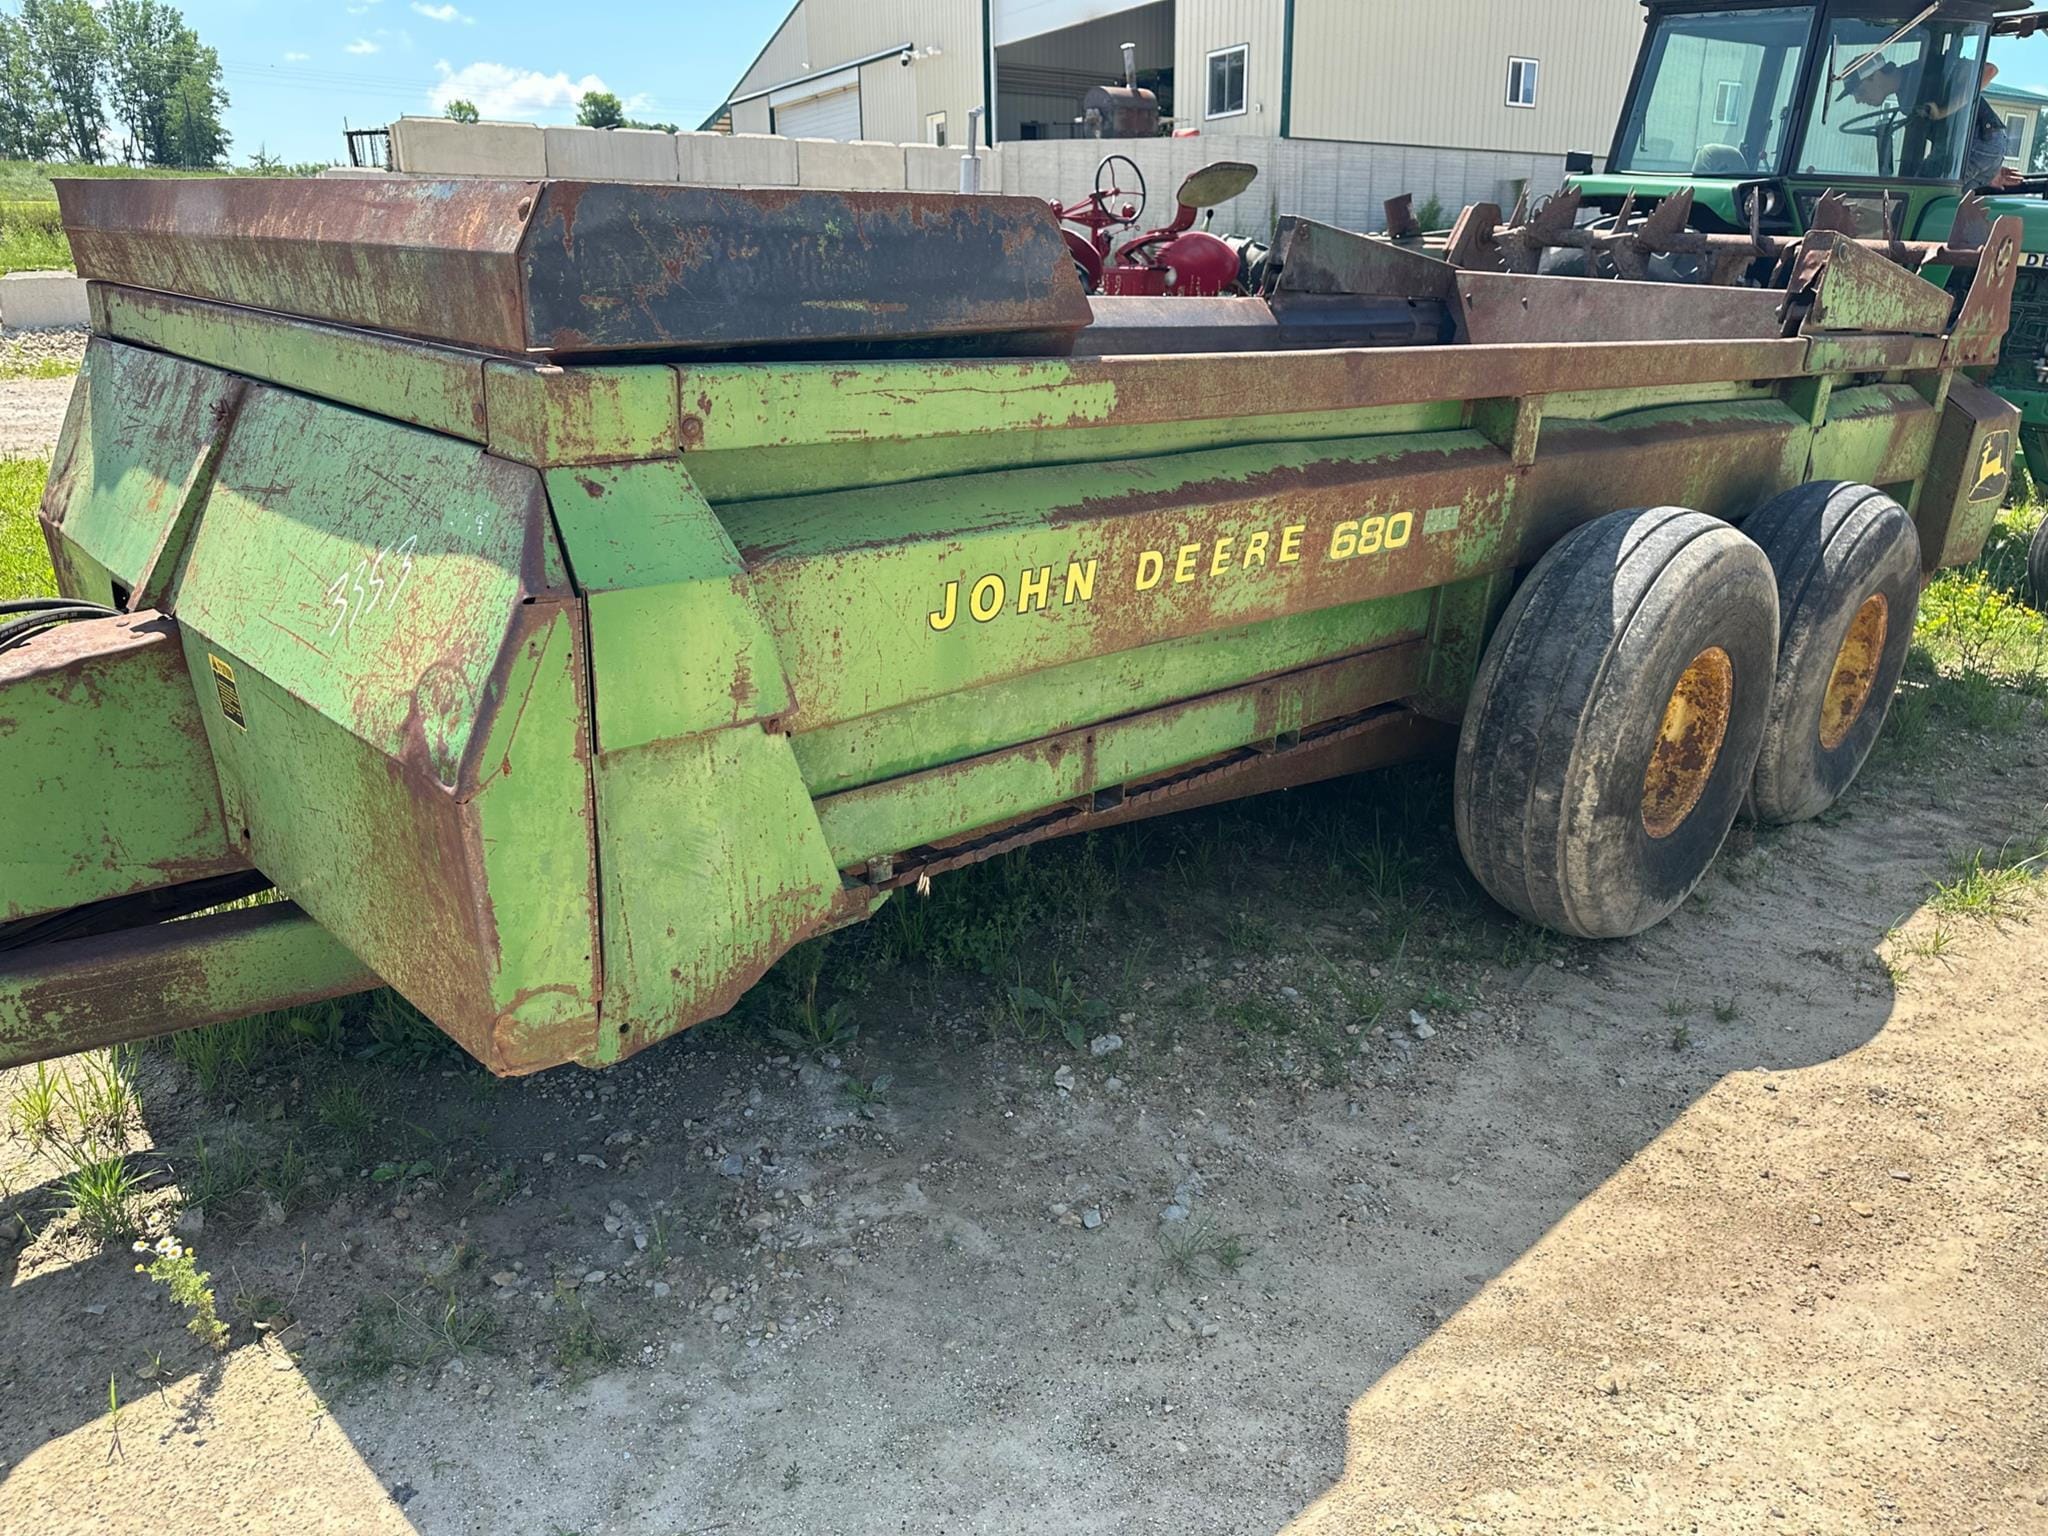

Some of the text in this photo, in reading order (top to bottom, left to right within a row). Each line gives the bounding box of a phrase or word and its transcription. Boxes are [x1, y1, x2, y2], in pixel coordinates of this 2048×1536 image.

[929, 511, 1413, 631] JOHN DEERE 680
